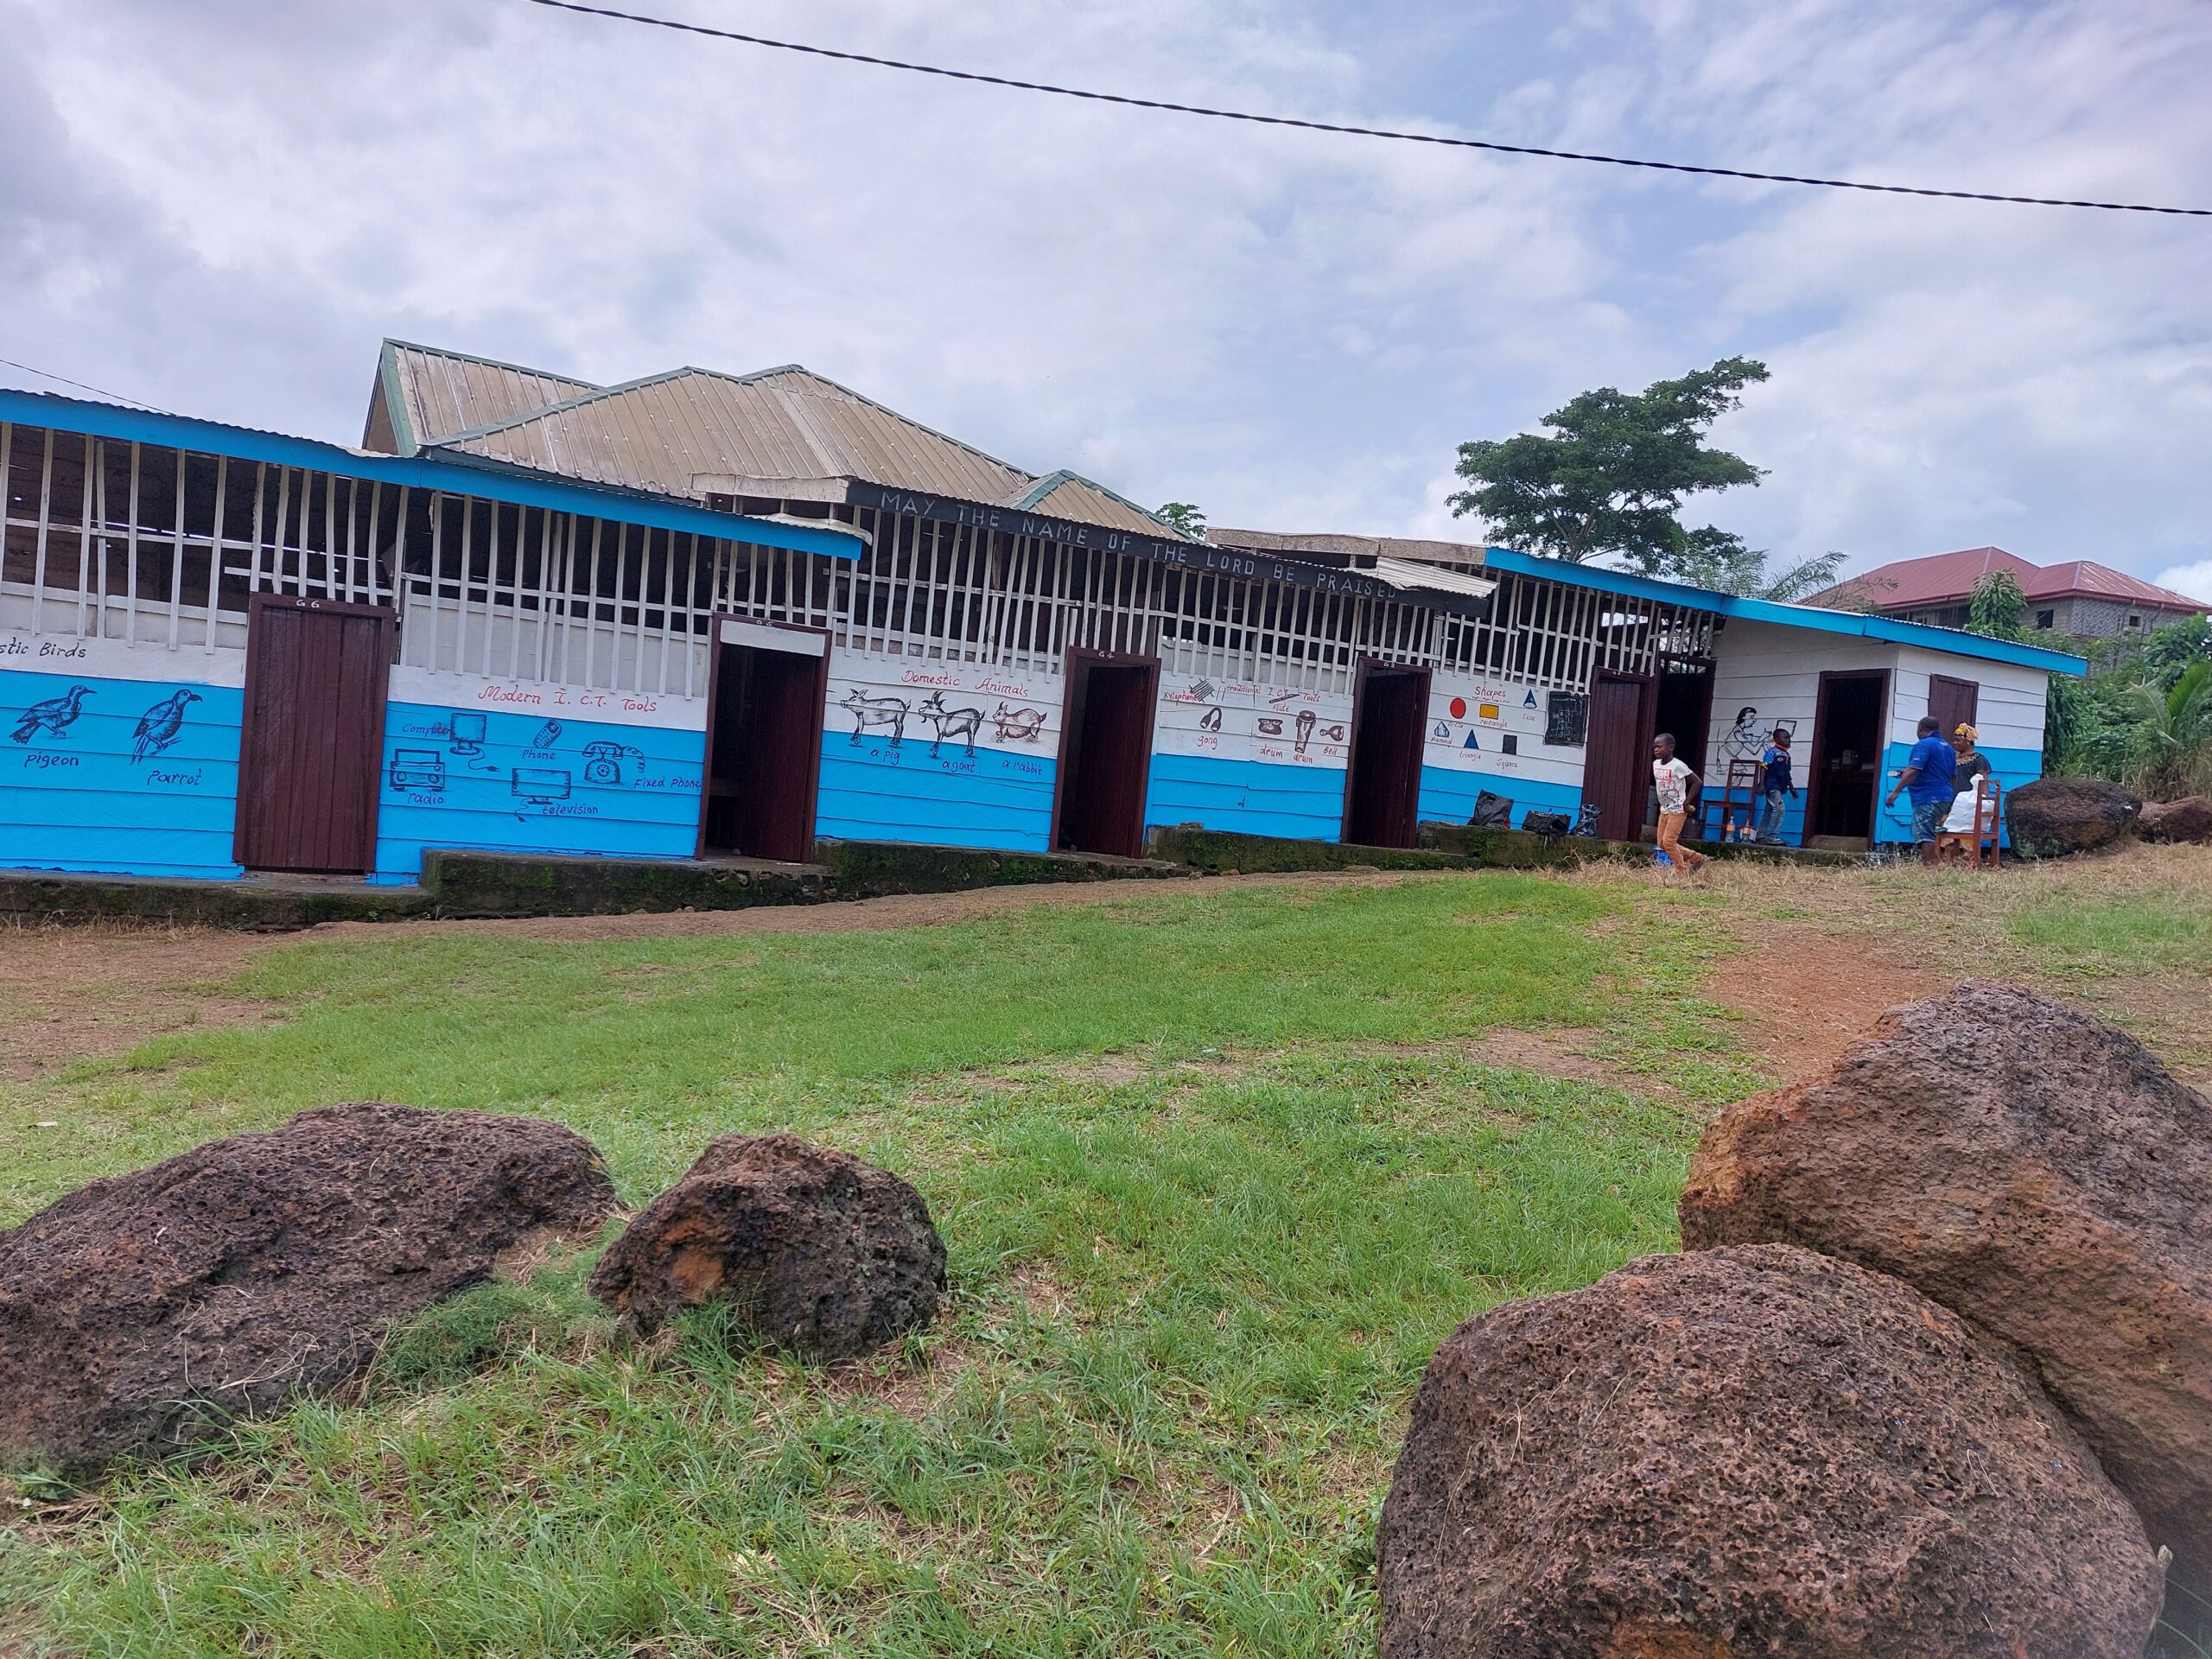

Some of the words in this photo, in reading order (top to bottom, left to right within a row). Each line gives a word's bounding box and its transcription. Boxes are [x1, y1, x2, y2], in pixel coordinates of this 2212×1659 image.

[880, 491, 937, 516] MAY
[956, 504, 1001, 527] THE
[1022, 516, 1089, 545] NAME
[1108, 532, 1131, 550] OF
[1151, 543, 1187, 563] THE
[1206, 550, 1255, 575] LORD
[1274, 564, 1295, 582] BE
[1317, 572, 1396, 599] PRAISED
[39, 642, 86, 658] Birds
[901, 671, 960, 687] Domestic
[976, 677, 1029, 697] Animals
[478, 684, 541, 704] Modern
[621, 696, 657, 712] Tools
[1474, 683, 1507, 701] Shapes
[1197, 735, 1218, 750] gong
[870, 748, 880, 758] a
[882, 749, 901, 766] pig
[1260, 744, 1283, 759] drum
[1293, 753, 1313, 764] drum
[942, 760, 950, 769] a
[951, 759, 976, 773] goat
[1002, 760, 1011, 768] a
[1013, 761, 1044, 776] rabbit
[633, 775, 665, 789] Fixed
[407, 791, 444, 804] radio
[542, 803, 599, 816] television
